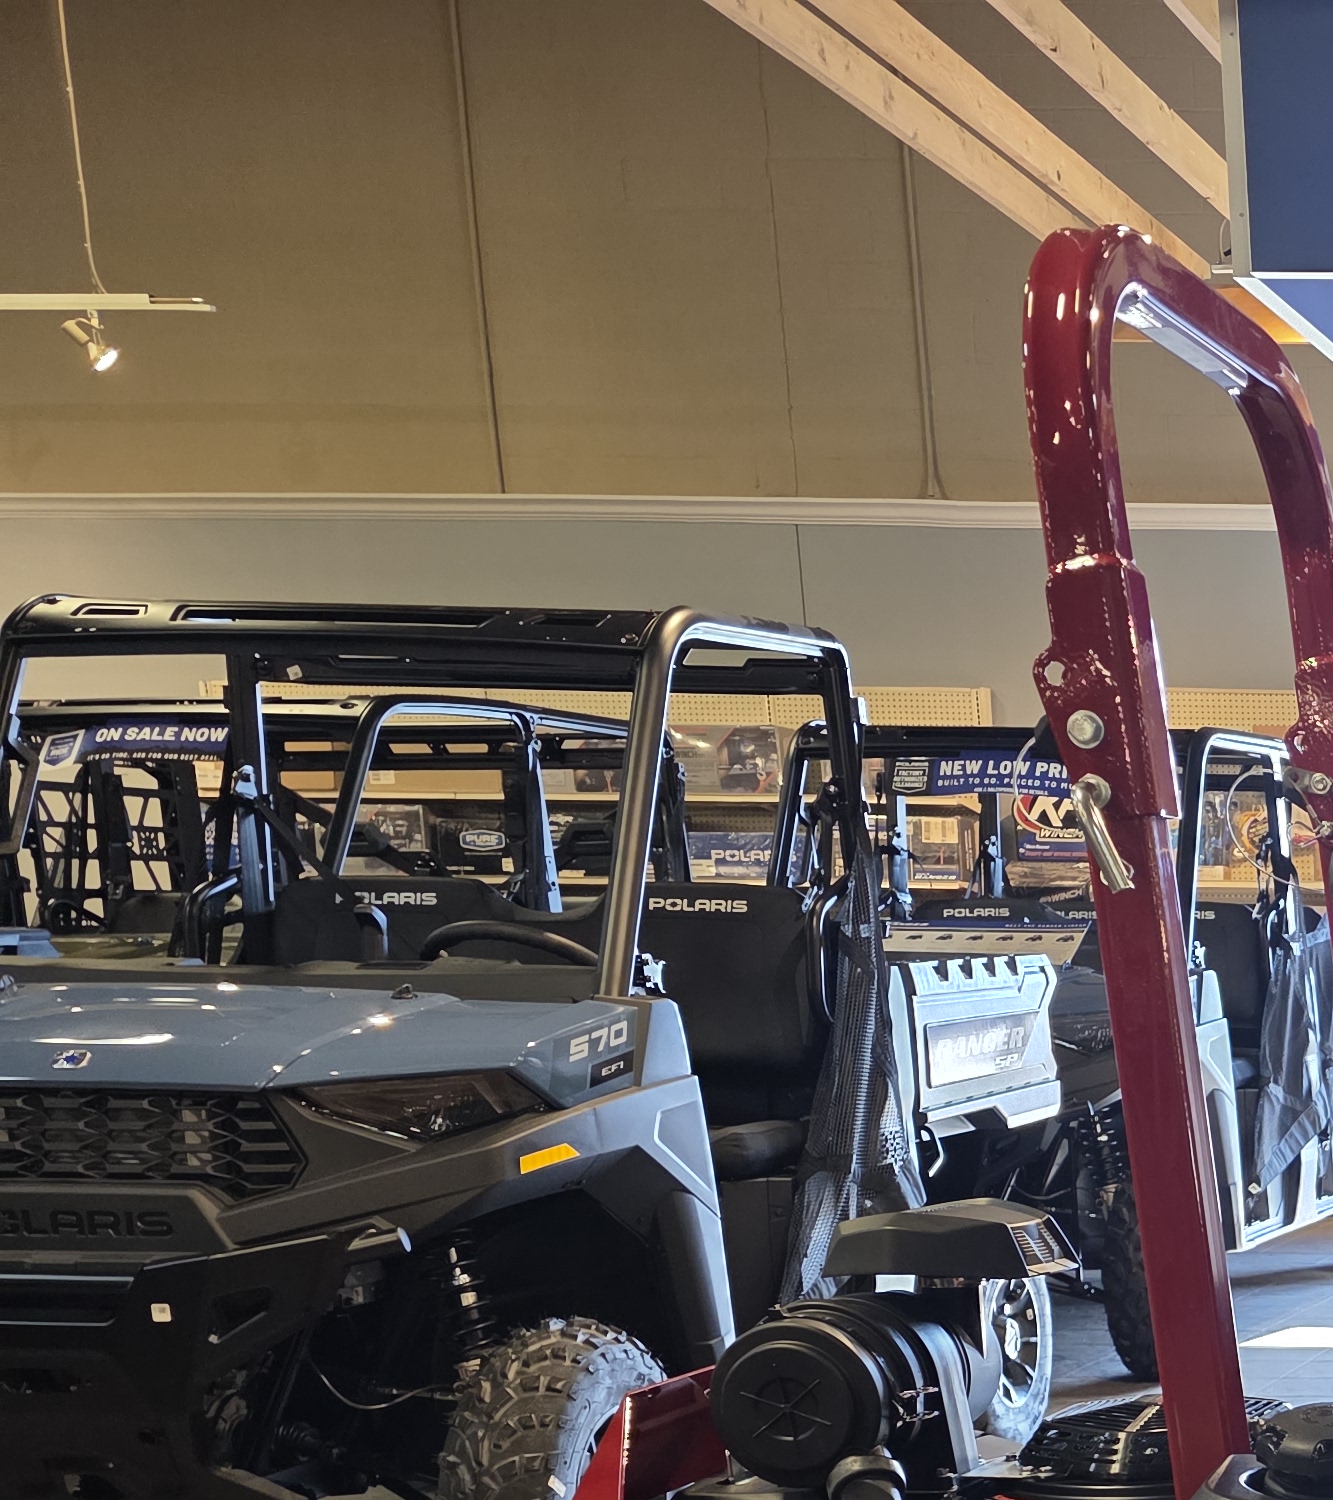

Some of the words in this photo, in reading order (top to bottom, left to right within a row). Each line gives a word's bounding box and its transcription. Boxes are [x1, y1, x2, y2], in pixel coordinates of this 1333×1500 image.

[95, 728, 123, 742] ON
[124, 727, 178, 742] SALE
[180, 727, 228, 742] NOW
[940, 760, 982, 776] NEW
[986, 760, 1030, 775] LOW
[938, 778, 964, 786] BUILT
[1044, 780, 1057, 788] TO
[466, 834, 498, 843] PURE
[648, 897, 748, 912] POLARIS
[943, 908, 1010, 917] POLARIS
[569, 1020, 628, 1062] 570
[936, 1026, 1024, 1060] RANGER
[602, 1061, 624, 1076] EFI
[994, 1054, 1020, 1068] SP
[0, 1210, 173, 1237] OLARIS
